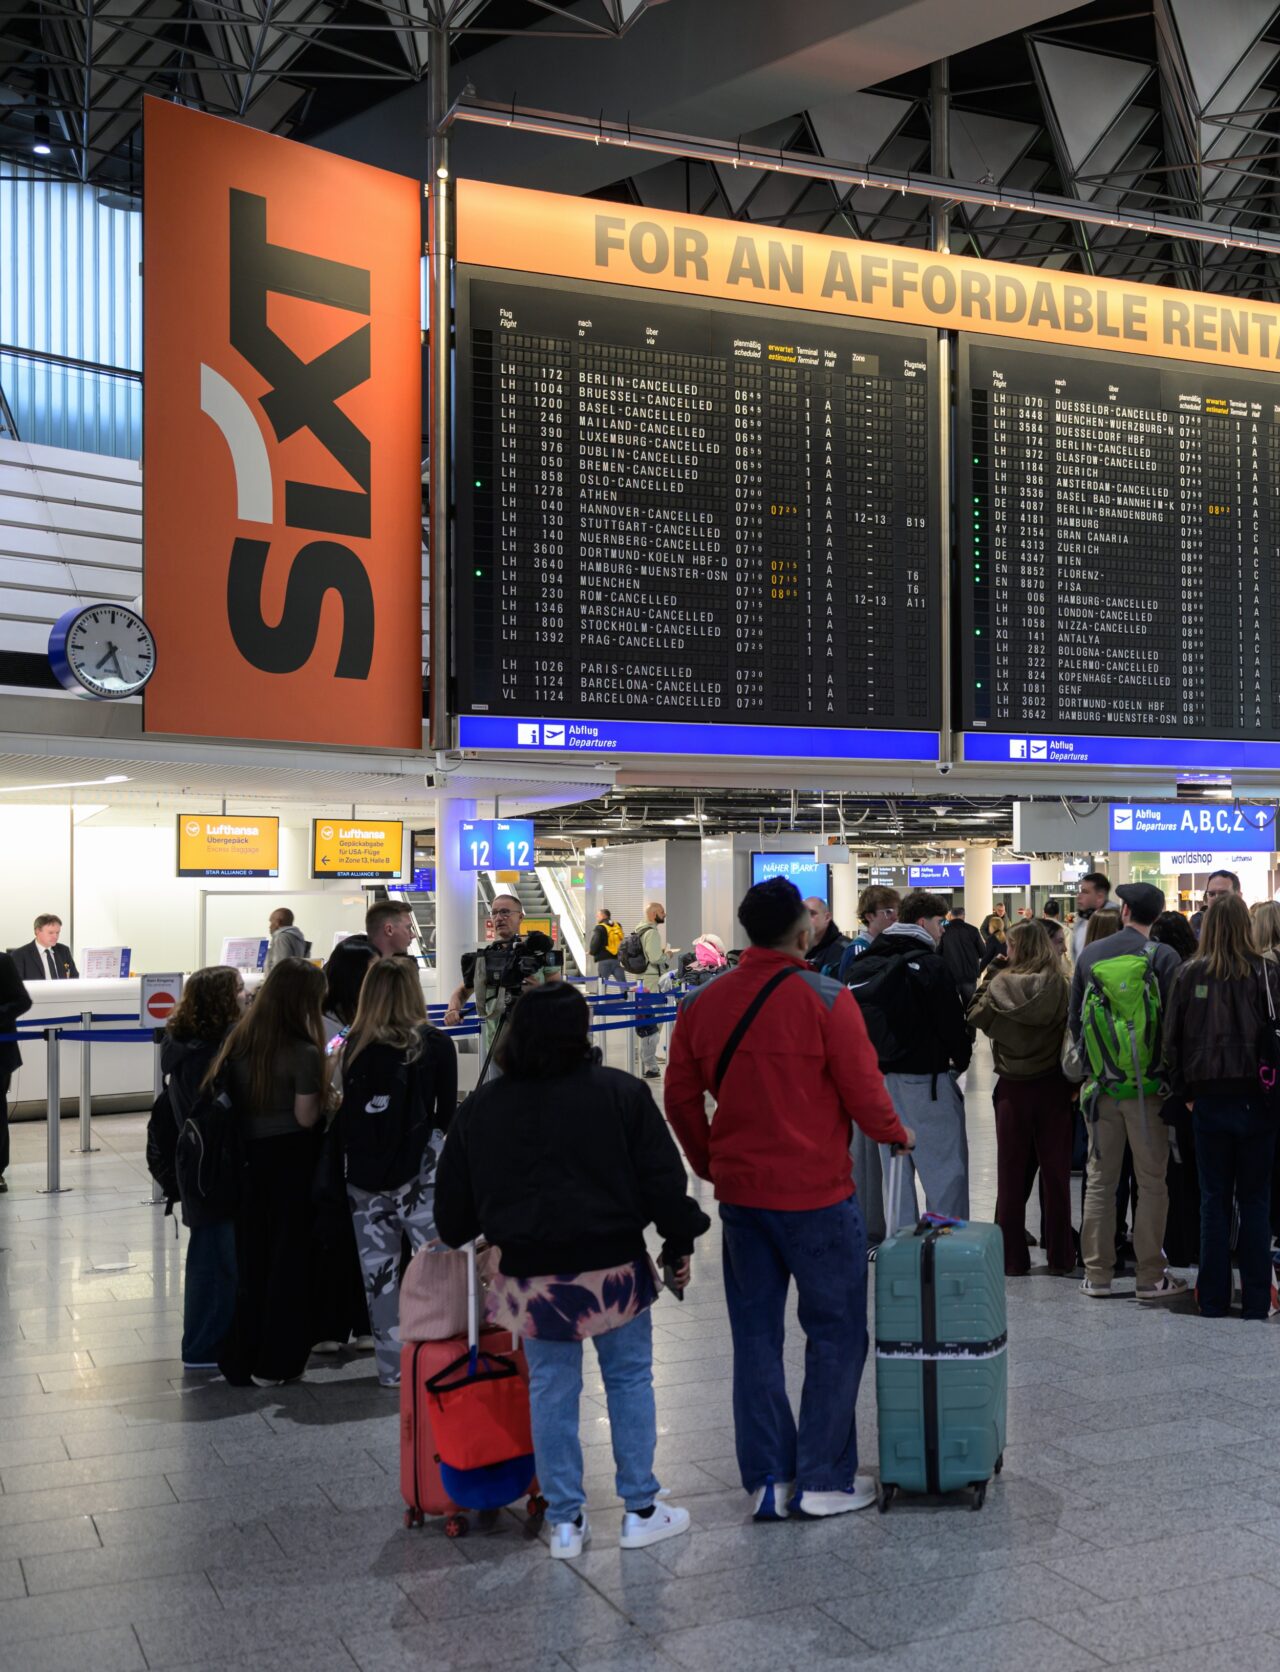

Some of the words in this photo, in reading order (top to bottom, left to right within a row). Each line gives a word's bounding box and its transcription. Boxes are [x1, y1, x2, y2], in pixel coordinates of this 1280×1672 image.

[594, 214, 708, 281] FOR
[726, 235, 803, 294] AN
[821, 251, 1147, 341] AFFORDABLE
[500, 309, 512, 319] Flug
[500, 319, 517, 328] Flight
[734, 349, 761, 358] scheduled
[768, 344, 793, 353] erwartet
[797, 346, 818, 356] Terminal
[768, 354, 796, 363] estimated
[541, 368, 562, 380] 172
[579, 372, 697, 395] BERLIN-CANCELLED
[534, 382, 562, 395] 1004
[579, 387, 711, 411] BRUESSEL-CANCELLED
[534, 397, 562, 409] 1200
[579, 401, 690, 422] BASEL-CANCELLED
[1055, 400, 1167, 422] DUESSELDR-CANCELLED
[579, 416, 704, 438] MAILAND-CANCELLED
[1055, 413, 1173, 435] MUENCHEN-WUERZBURG-N
[201, 187, 375, 680] SIXT
[579, 430, 719, 454] LUXEMBURG-CANCELLED
[1056, 439, 1150, 458] BERLIN-CANCELLED
[579, 445, 697, 466] DUBLIN-CANCELLED
[579, 459, 697, 480] BREMEN-CANCELLED
[1056, 465, 1098, 478] ZUERICH
[579, 474, 683, 493] OSLO-CANCELLED
[1056, 478, 1168, 497] AMSTERDAM-CANCELLED
[534, 485, 563, 497] 1278
[579, 488, 616, 501] ATHEN
[579, 503, 712, 523] HANNOVER-CANCELLED
[1056, 504, 1162, 522] BERLIN-BRANDENBURG
[579, 517, 719, 538] STUTTGART-CANCELLED
[1057, 517, 1098, 529] HAMBURG
[580, 532, 719, 552] NUERNBERG-CANCELLED
[1057, 530, 1080, 540] GRAN
[1087, 532, 1128, 544] CANARIA
[533, 543, 563, 555] 3600
[580, 546, 683, 564] DORTMUND-KOELN
[691, 555, 726, 567] HBF-D
[534, 558, 563, 570] 3640
[580, 561, 726, 581] HAMBURG-MUENSTER-OSN
[541, 573, 563, 584] 094
[580, 576, 639, 589] MUENCHEN
[580, 590, 676, 606] ROM-CANCELLED
[1058, 594, 1157, 610] HAMBURG-CANCELLED
[535, 602, 563, 613] 1346
[580, 605, 712, 622] WARSCHAU-CANCELLED
[1058, 607, 1152, 622] LONDON-CANCELLED
[580, 619, 720, 637] STOCKHOLM-CANCELLED
[1058, 620, 1146, 634] NIZZA-CANCELLED
[535, 631, 563, 642] 1392
[580, 634, 684, 649] PRAG-CANCELLED
[1058, 633, 1099, 644] ANTALYA
[1058, 646, 1158, 660] BOLOGNA-CANCELLED
[535, 661, 563, 672] 1026
[580, 663, 691, 678] PARIS-CANCELLED
[1058, 659, 1158, 673] PALERMO-CANCELLED
[535, 675, 564, 686] 1124
[580, 677, 720, 693] BARCELONA-CANCELLED
[1058, 672, 1170, 686] KOPENHAGE-CANCELLED
[535, 690, 564, 701] 1124
[580, 692, 720, 707] BARCELONA-CANCELLED
[1059, 710, 1176, 724] HAMBURG-MUENSTER-OSN
[569, 725, 598, 736] Abflug
[569, 738, 617, 748] Departures
[1050, 741, 1073, 751] Abflug
[1050, 752, 1088, 761] Departures
[1135, 809, 1161, 821] Abflug
[206, 824, 259, 835] Lufthansa
[339, 829, 385, 839] Lufthansa
[1136, 821, 1177, 832] Departures
[207, 837, 248, 845] Übergepäck
[470, 841, 489, 866] 12
[507, 841, 529, 866] 12
[1171, 851, 1213, 866] worldshop
[763, 862, 789, 872] NÄHER
[791, 862, 819, 873] PARKT
[942, 867, 950, 877] A
